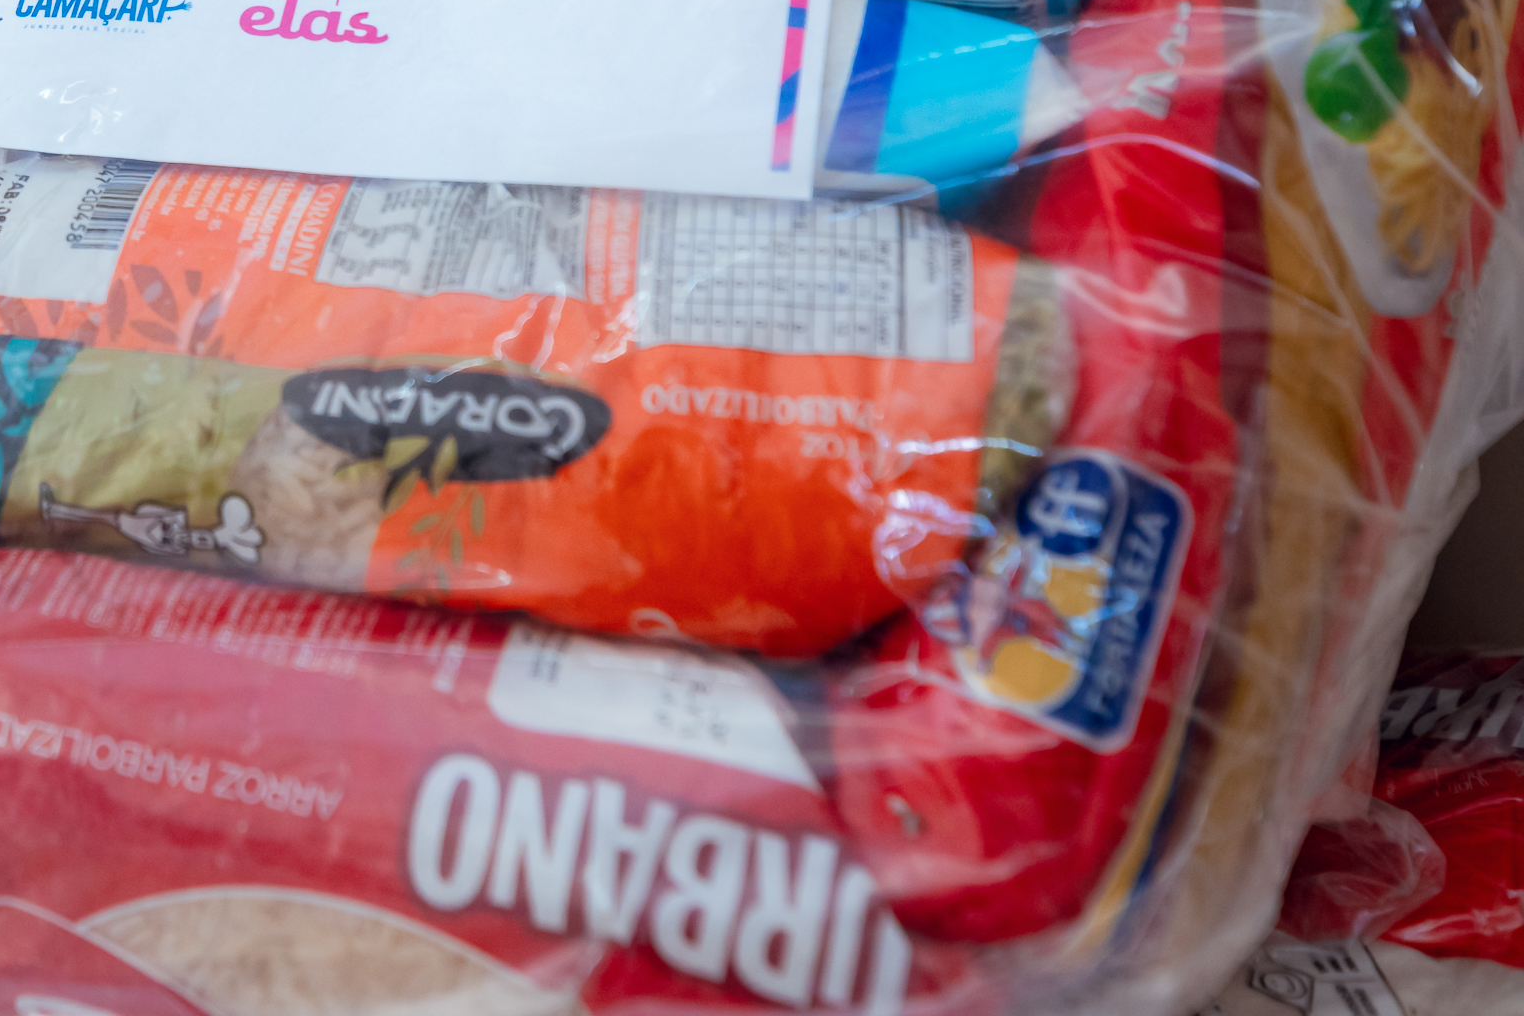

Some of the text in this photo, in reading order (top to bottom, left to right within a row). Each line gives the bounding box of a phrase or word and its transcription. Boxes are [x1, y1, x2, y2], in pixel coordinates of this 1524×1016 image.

[66, 188, 103, 245] 200458
[312, 380, 587, 460] CORADINI
[213, 752, 343, 821] ARROZ
[406, 751, 914, 1016] URBANO
